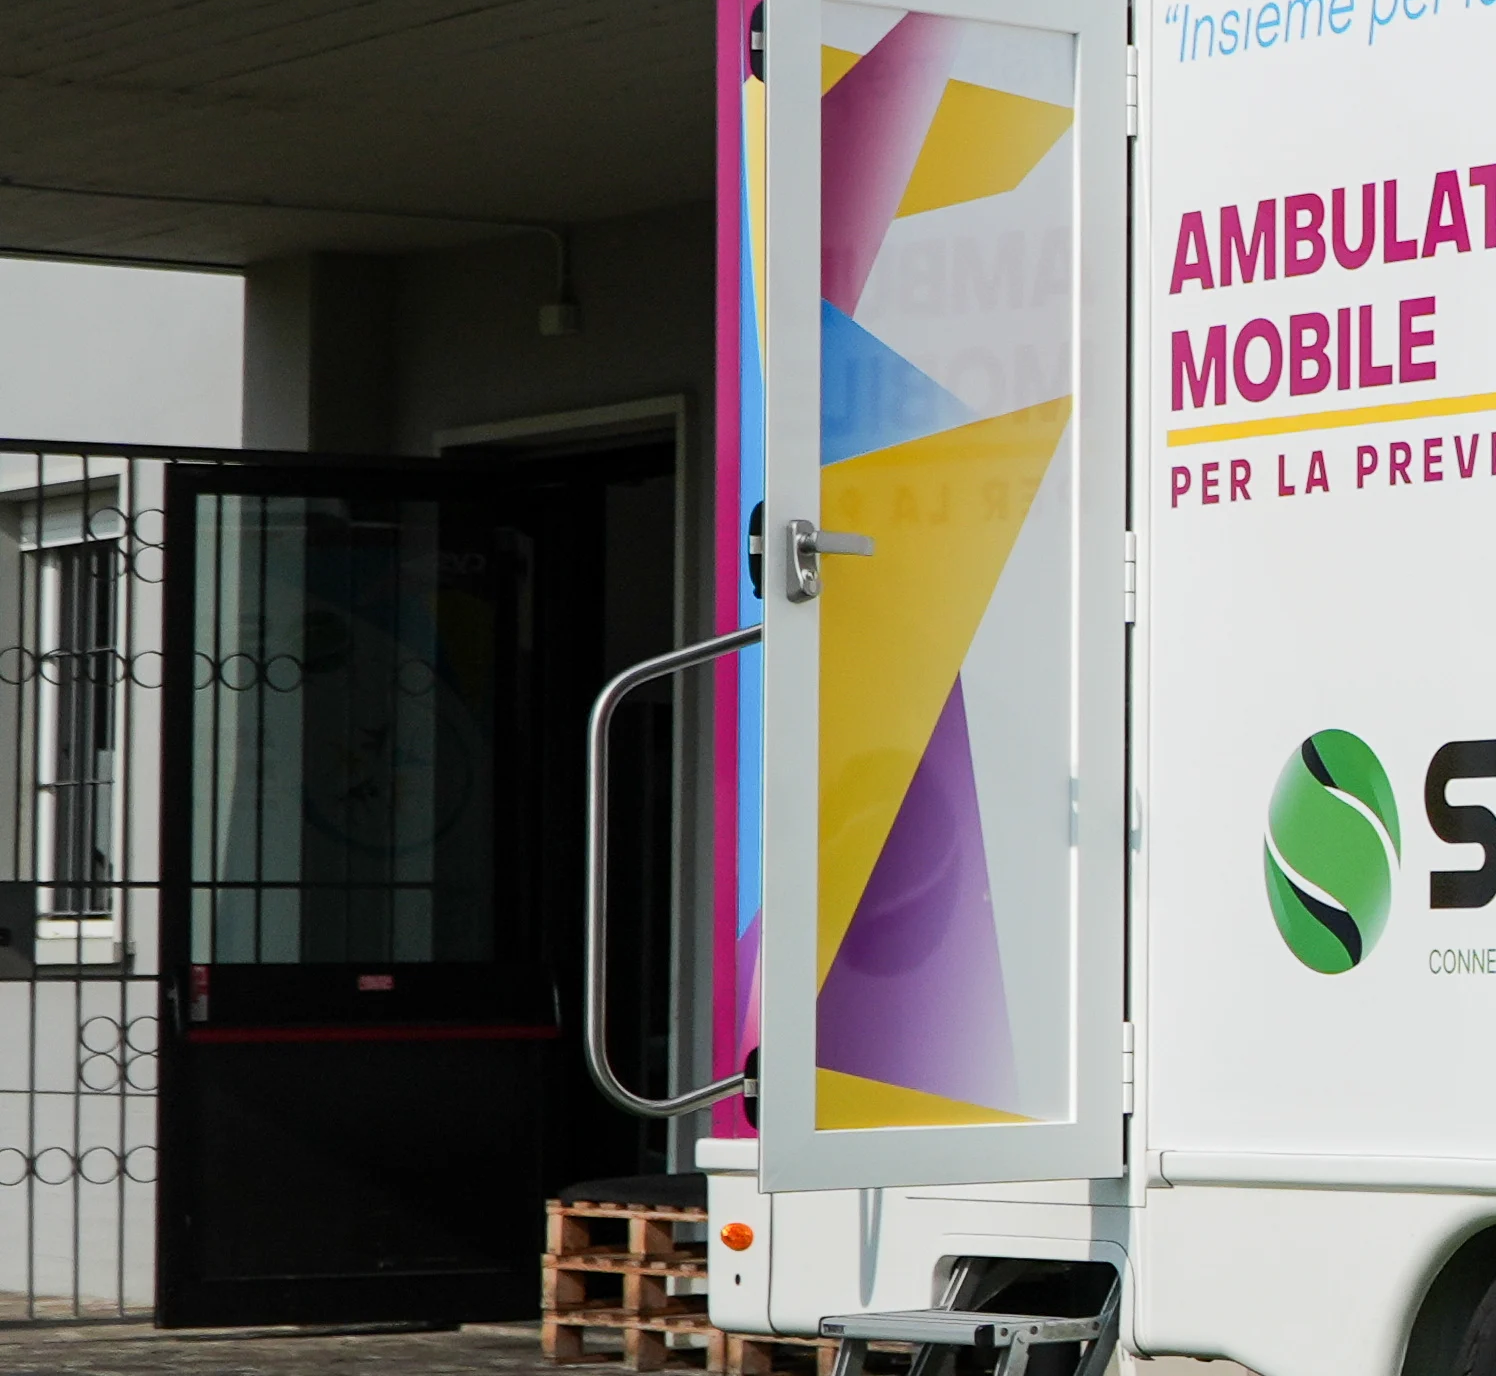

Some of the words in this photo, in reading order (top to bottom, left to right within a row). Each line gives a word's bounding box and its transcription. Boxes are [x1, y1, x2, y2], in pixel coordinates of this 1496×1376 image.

[1170, 295, 1438, 413] MOBILE
[1170, 457, 1254, 510] PER
[1276, 449, 1331, 499] LA
